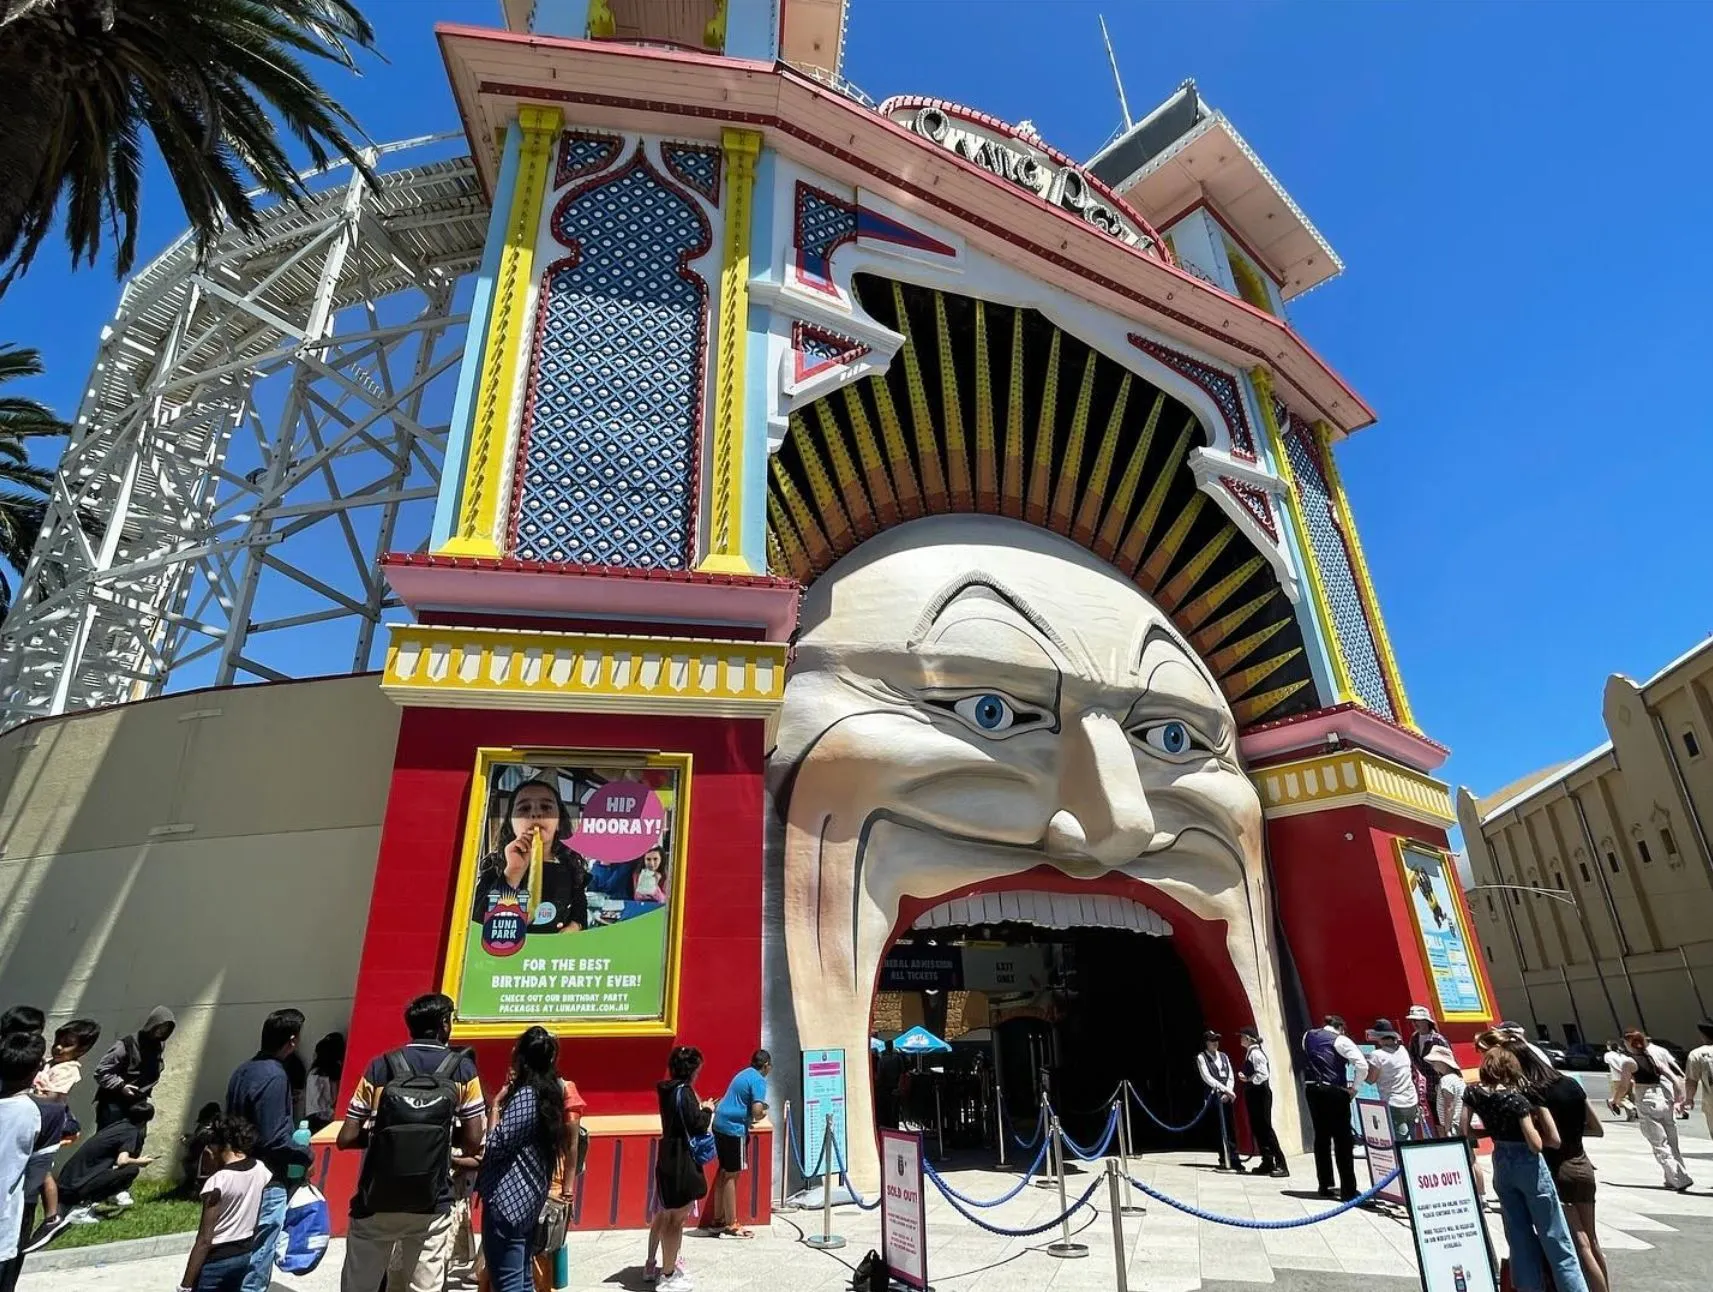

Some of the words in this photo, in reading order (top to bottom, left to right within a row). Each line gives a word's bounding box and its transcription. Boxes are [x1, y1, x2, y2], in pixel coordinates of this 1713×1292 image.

[606, 797, 636, 812] HIP
[582, 818, 661, 834] HOORAY!
[492, 919, 517, 929] LUNA
[491, 929, 517, 939] PARK
[523, 959, 546, 971] FOR
[551, 959, 576, 971] THE
[579, 959, 611, 971] BEST
[492, 975, 557, 988] BIRTHDAY
[561, 975, 602, 988] PARTY
[606, 975, 642, 987] EVER!
[500, 995, 525, 1003] CHECK
[527, 994, 543, 1002] OUT
[545, 994, 560, 1002] OUR
[563, 994, 600, 1002] BIRTHDAY
[603, 993, 629, 1002] PARTY
[499, 1004, 541, 1013] PACKAGES
[542, 1004, 554, 1012] AT
[556, 1003, 630, 1012] LUNAPARK.COM.AU
[1418, 1174, 1439, 1189] SOLD
[1441, 1171, 1461, 1186] OUT!
[887, 1184, 902, 1199] SOLD
